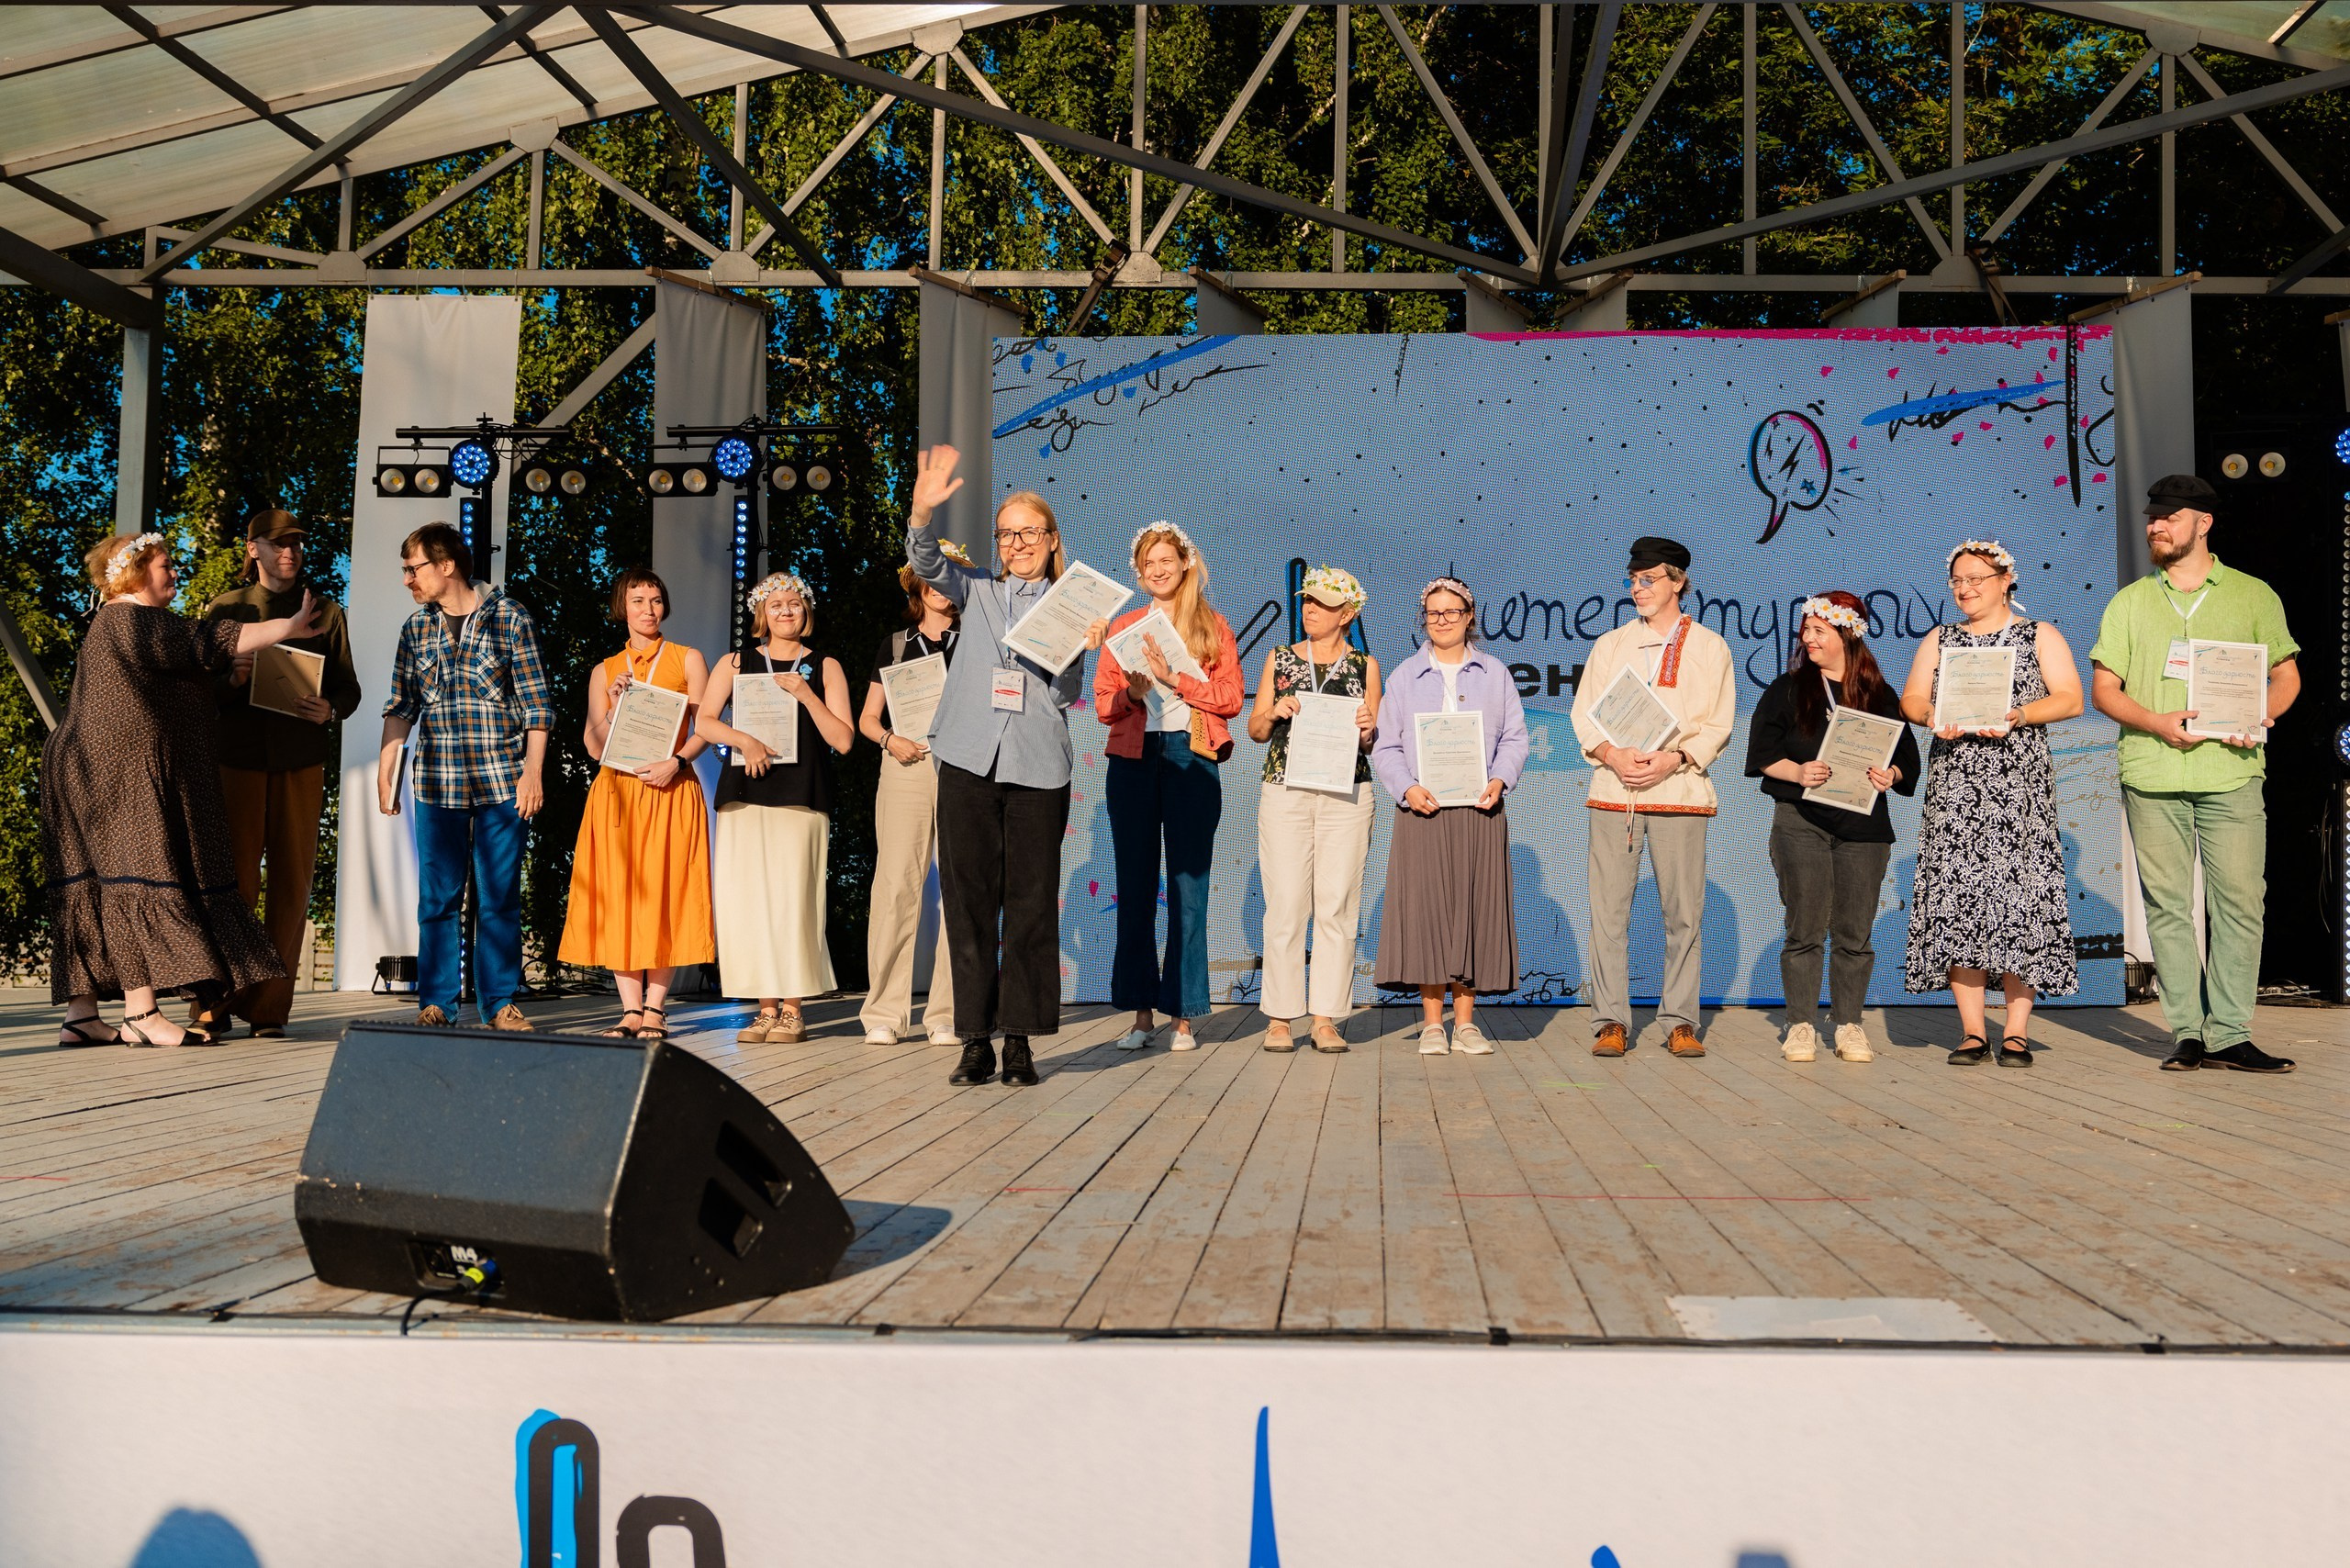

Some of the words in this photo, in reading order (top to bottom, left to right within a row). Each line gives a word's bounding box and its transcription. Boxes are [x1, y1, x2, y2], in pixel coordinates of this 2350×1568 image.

[1950, 670, 2004, 680] Благодарность
[2199, 666, 2256, 680] Благодарность
[1835, 735, 1886, 755] Благодарность
[450, 1245, 478, 1264] M4
